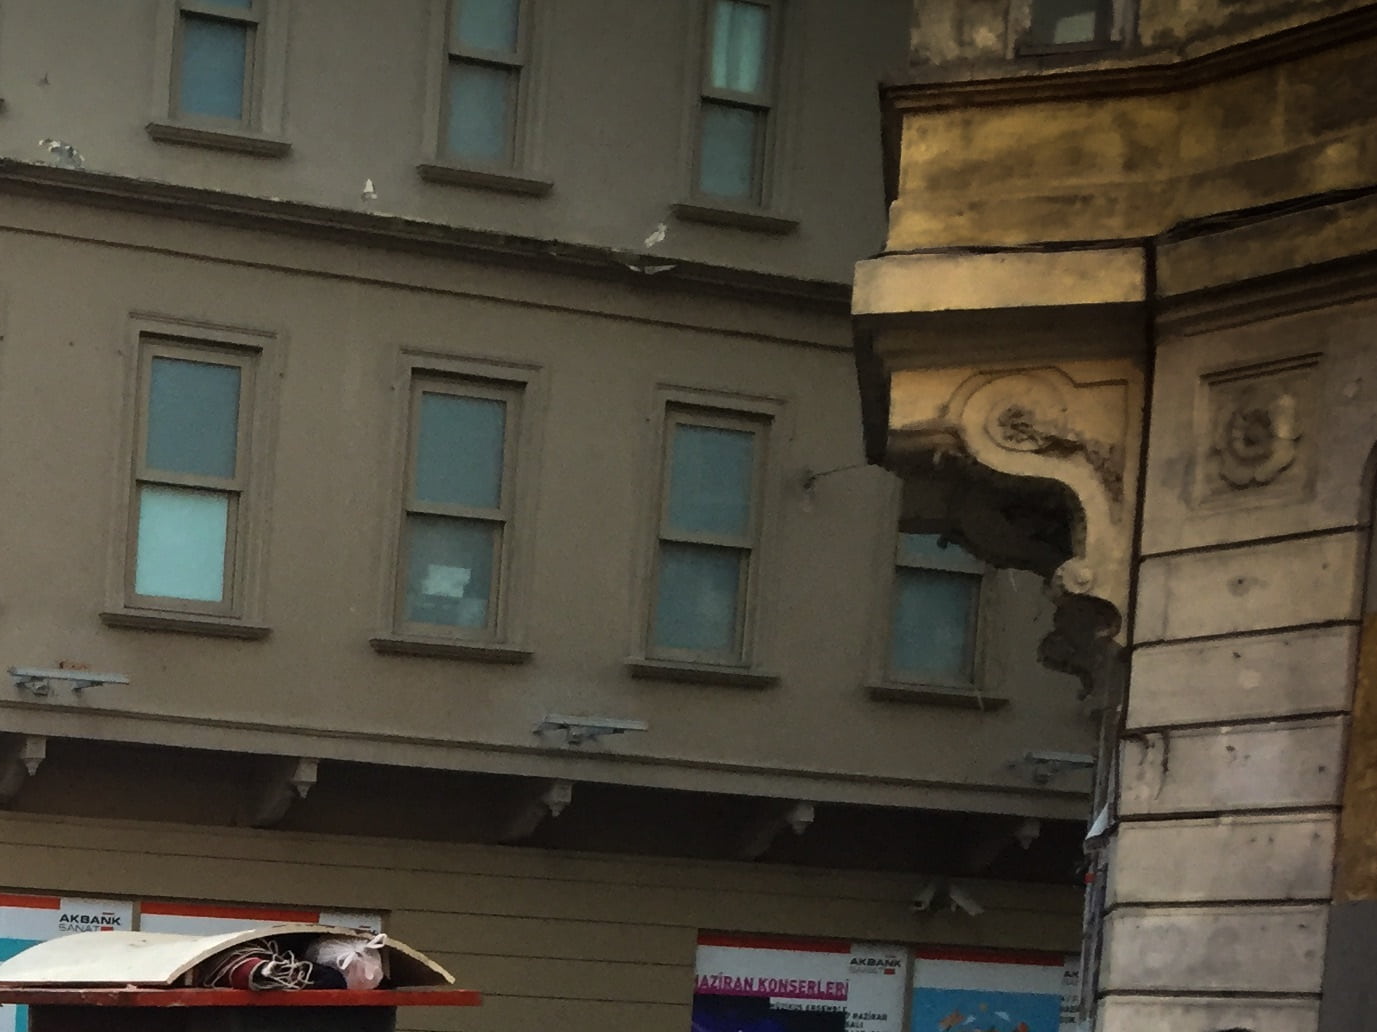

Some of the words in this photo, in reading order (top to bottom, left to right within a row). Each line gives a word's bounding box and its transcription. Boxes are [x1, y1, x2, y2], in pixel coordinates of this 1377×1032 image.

[59, 914, 121, 926] AKBANK
[58, 923, 101, 933] SANAT
[850, 957, 902, 968] AKBANK
[758, 978, 849, 996] KONSERLERİ
